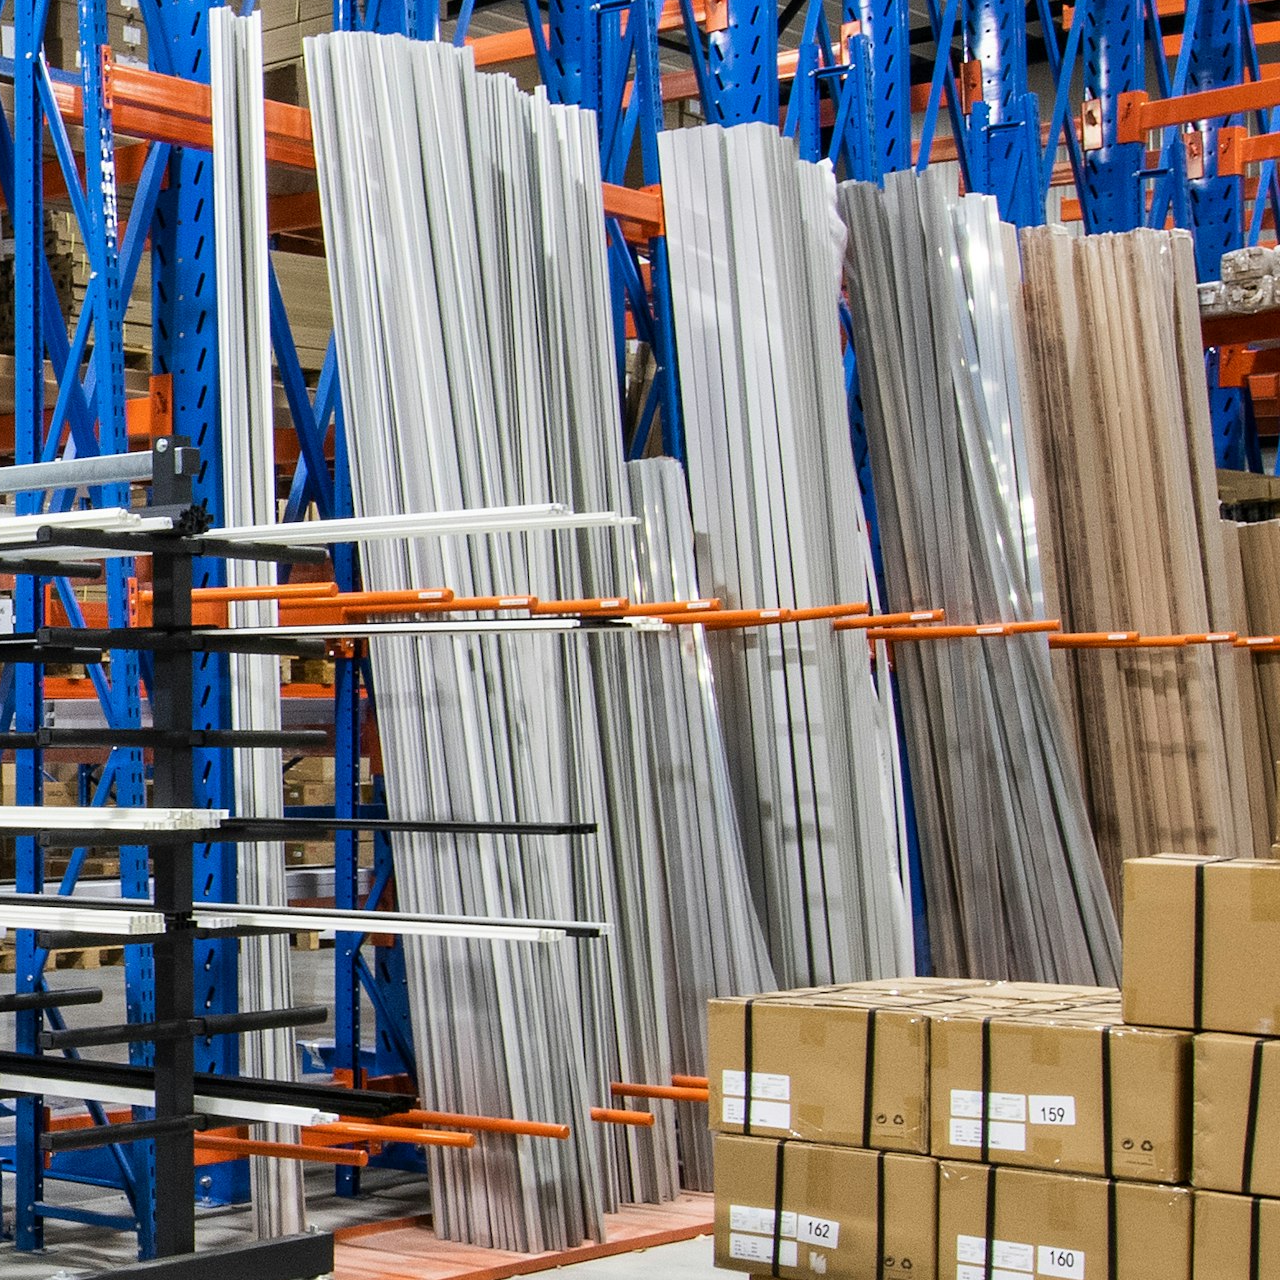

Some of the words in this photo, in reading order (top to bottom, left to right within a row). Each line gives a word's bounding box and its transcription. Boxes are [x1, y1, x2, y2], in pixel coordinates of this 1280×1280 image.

[1041, 1107, 1065, 1123] 159
[807, 1221, 830, 1239] 162
[1050, 1250, 1075, 1268] 160
